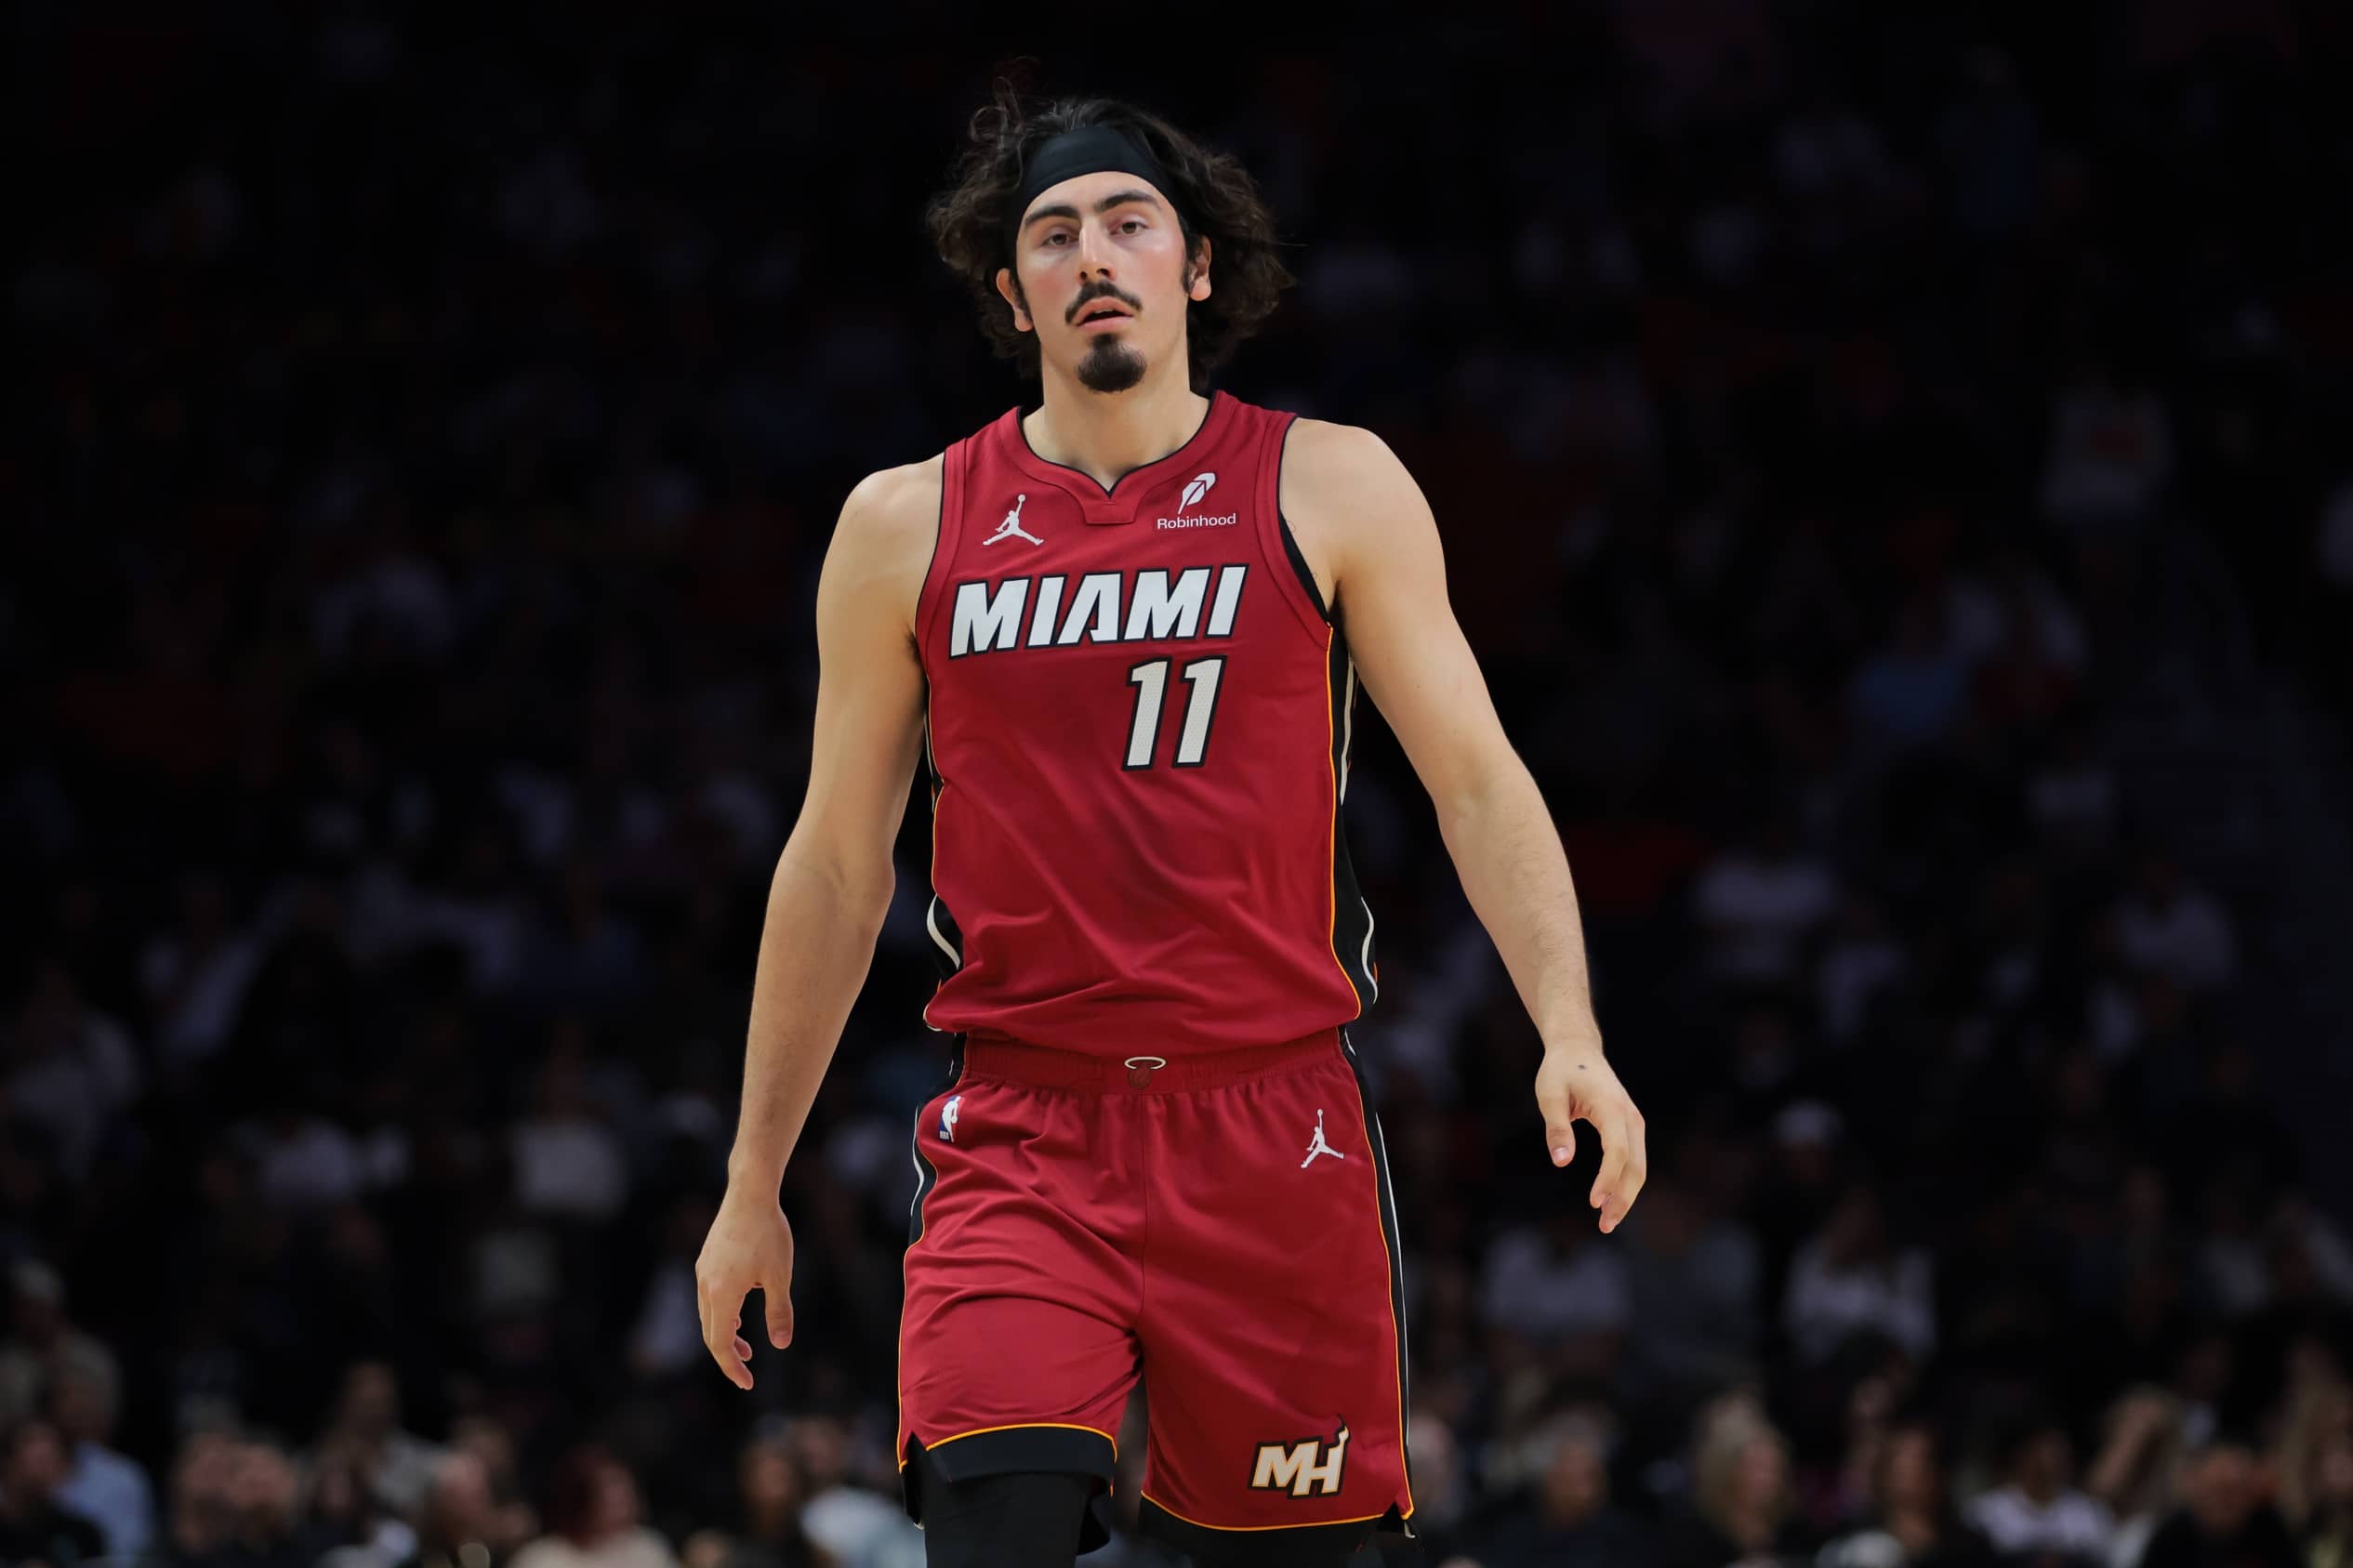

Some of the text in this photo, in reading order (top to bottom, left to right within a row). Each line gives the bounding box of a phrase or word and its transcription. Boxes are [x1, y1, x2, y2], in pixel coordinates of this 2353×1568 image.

[1157, 512, 1237, 530] Robinhood
[948, 563, 1249, 659] MIAMI
[1121, 655, 1227, 771] 11
